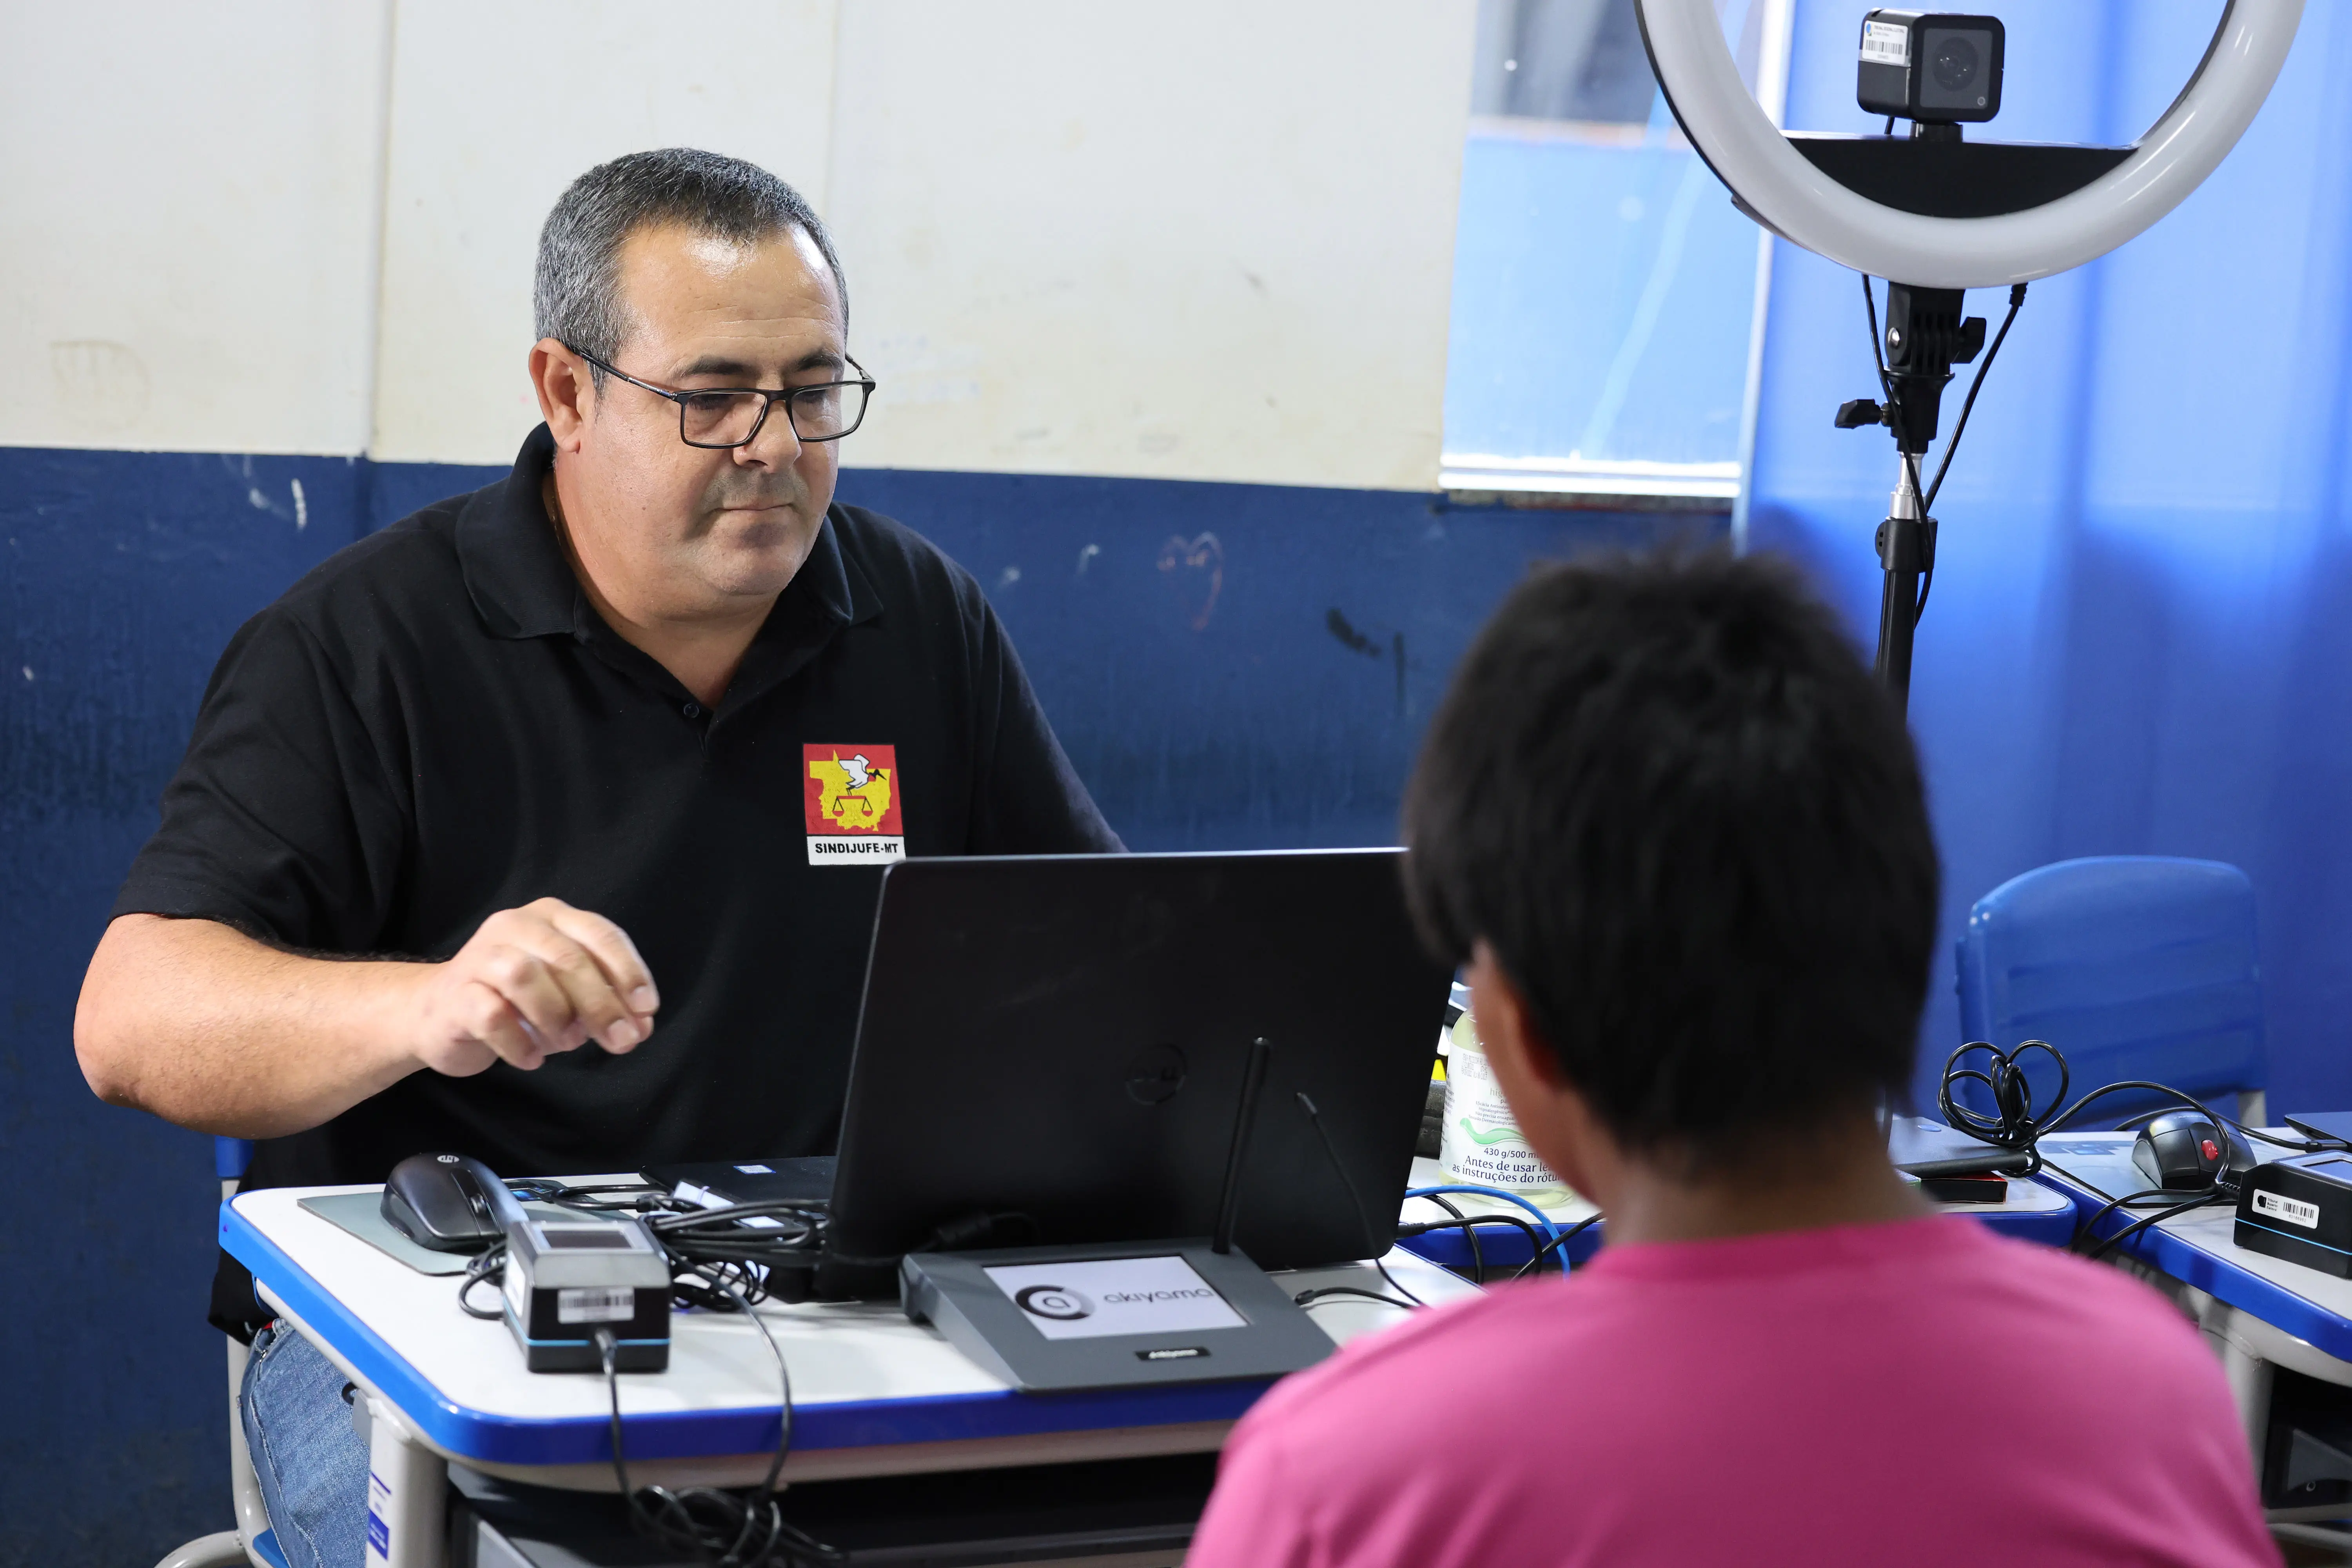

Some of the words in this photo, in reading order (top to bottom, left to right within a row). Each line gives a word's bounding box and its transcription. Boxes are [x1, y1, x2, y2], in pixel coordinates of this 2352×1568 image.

[815, 842, 898, 854] SINDIJUFE-MT
[1501, 1150, 1526, 1158] g/500
[1465, 1156, 1493, 1169] Antes
[1497, 1161, 1509, 1171] de
[1452, 1164, 1460, 1172] as
[1463, 1165, 1517, 1183] instruções
[1520, 1173, 1534, 1183] do
[1103, 1287, 1214, 1303] akiyama
